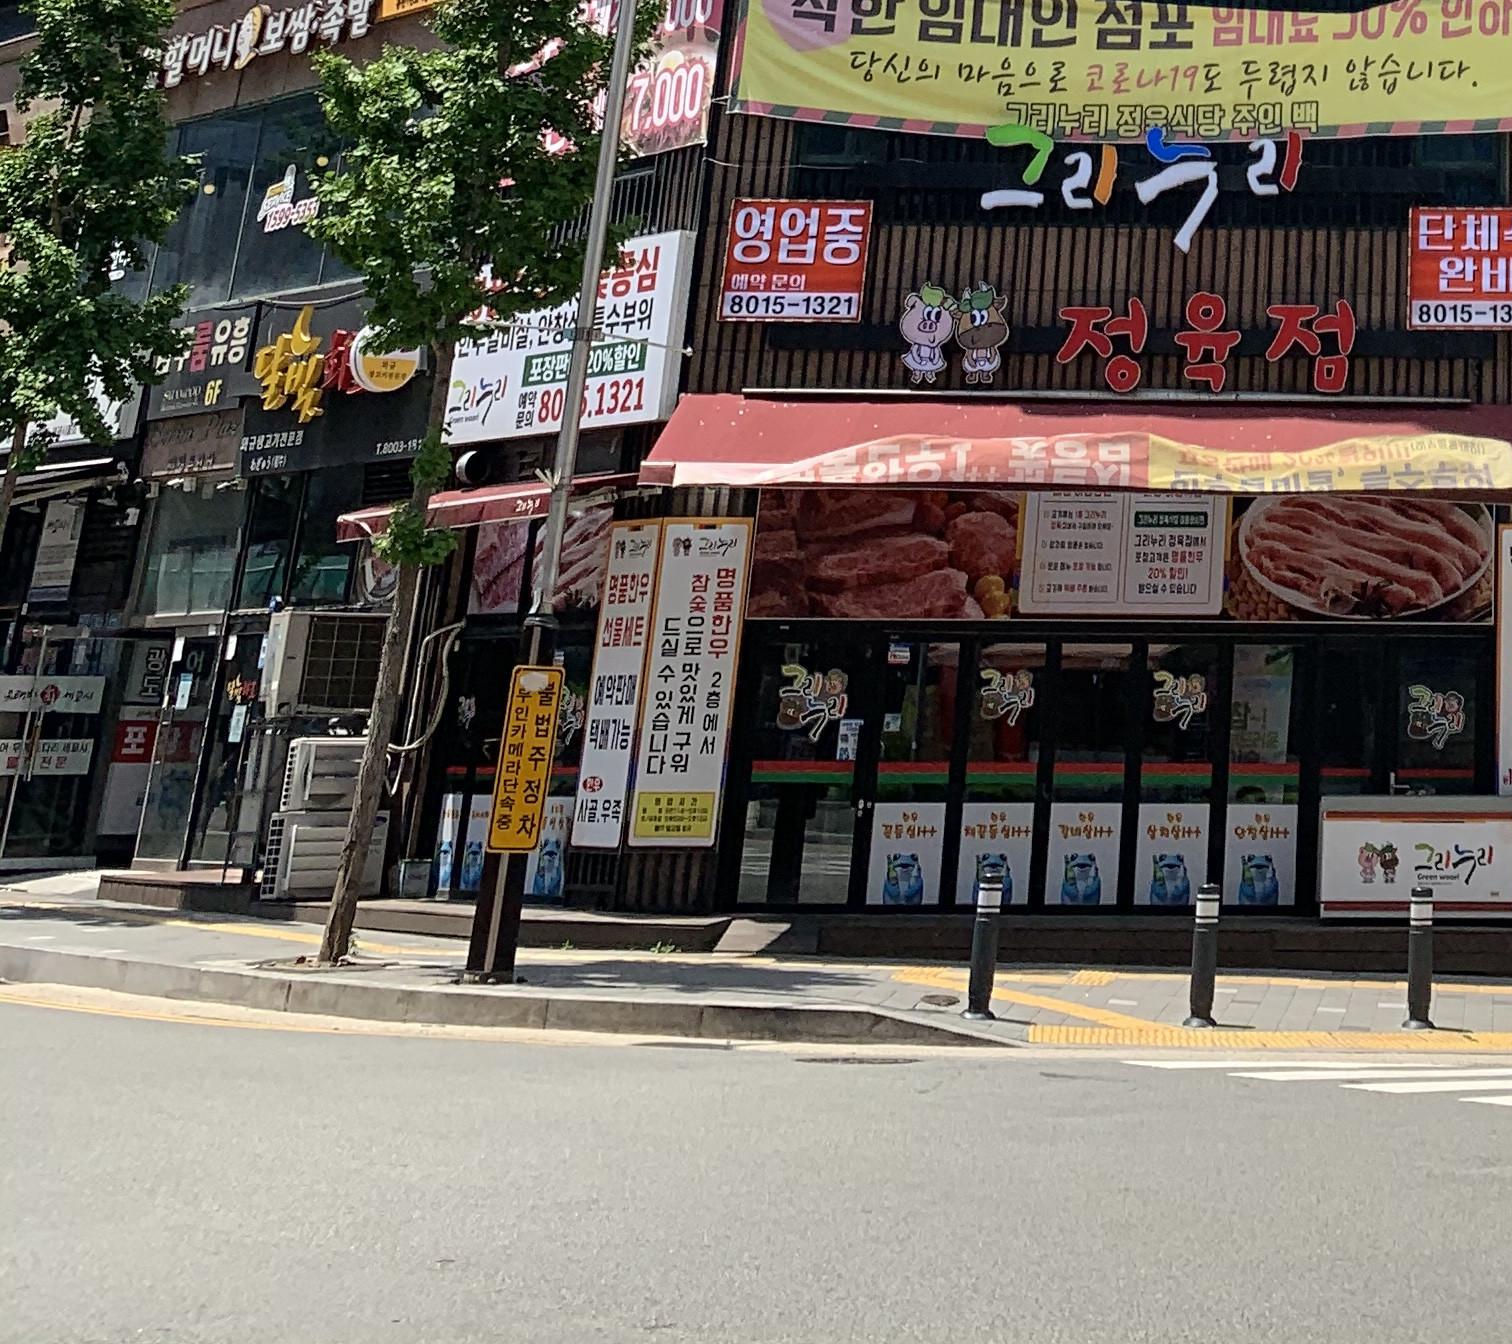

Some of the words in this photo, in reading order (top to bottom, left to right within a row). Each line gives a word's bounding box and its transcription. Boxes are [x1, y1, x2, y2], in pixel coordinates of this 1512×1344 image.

[162, 23, 239, 89] 할머니
[848, 51, 942, 85] 당신의
[957, 55, 1069, 98] 마음으로
[1238, 58, 1329, 100] 두렵지
[1344, 53, 1479, 97] 않습니다.
[629, 64, 703, 130] 7,000
[1005, 101, 1108, 139] 그리누리
[1116, 100, 1226, 140] 정육식당
[1231, 102, 1284, 139] 주인
[1290, 100, 1319, 135] 백
[731, 206, 866, 266] 영업중
[730, 272, 767, 292] 예약
[769, 272, 807, 292] 문의
[728, 295, 855, 317] 8015-1321
[1056, 291, 1357, 394] 정육점
[203, 378, 224, 406] 6F
[515, 409, 535, 429] 문의
[607, 572, 650, 606] 명품한우
[602, 616, 645, 648] 선물세트
[707, 567, 737, 660] 명품한우
[660, 616, 682, 658] 드실
[656, 665, 677, 687] 수
[675, 662, 703, 727] 맛있게
[644, 688, 675, 776] 있습니다
[700, 671, 724, 757] 2층에서
[516, 681, 557, 841] 불법주정차
[669, 732, 694, 775] 구워
[1414, 842, 1493, 886] 그리누리
